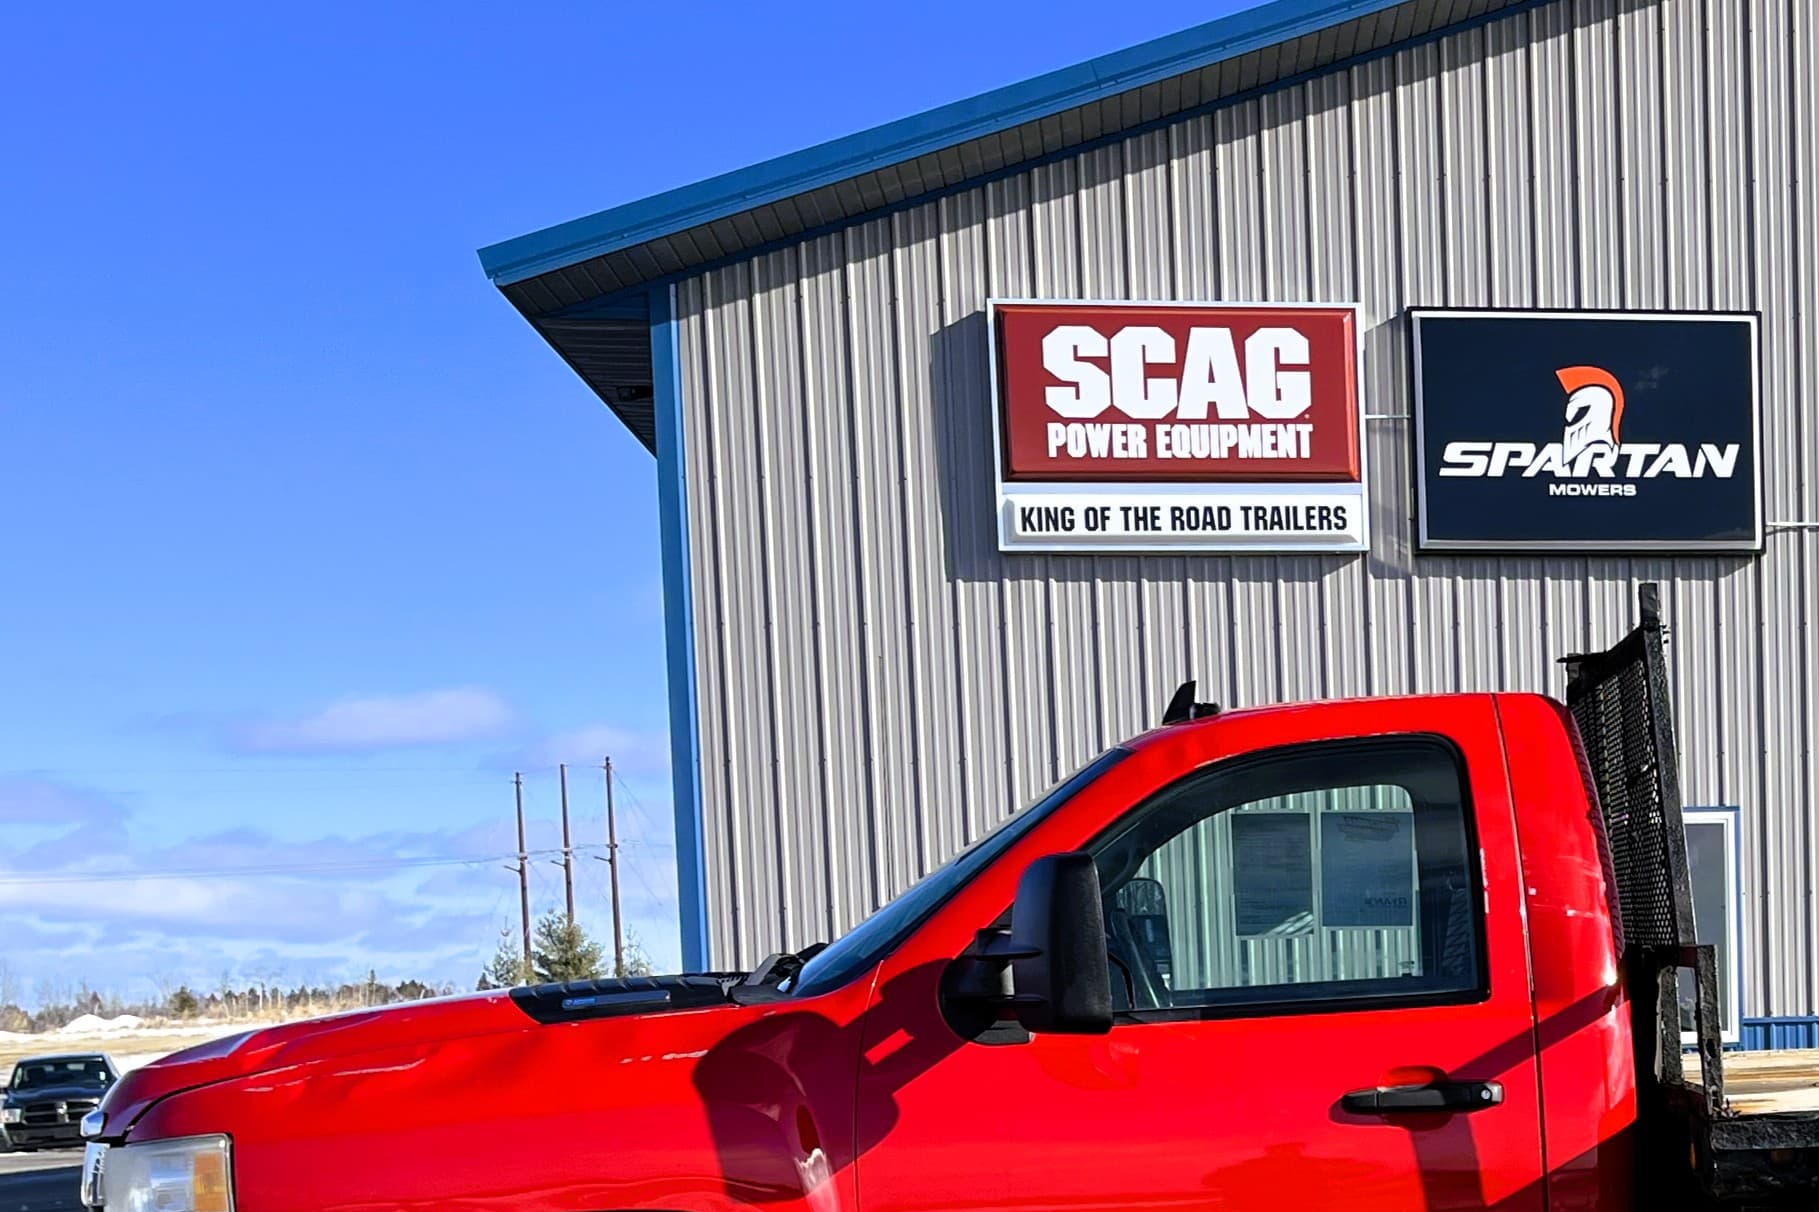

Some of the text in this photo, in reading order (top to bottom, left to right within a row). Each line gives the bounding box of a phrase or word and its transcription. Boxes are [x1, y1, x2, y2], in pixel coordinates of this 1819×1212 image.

[1042, 325, 1312, 419] SCAG
[1047, 423, 1314, 459] POWER EQUIPMENT
[1439, 441, 1740, 478] SPARTAN
[1549, 484, 1637, 496] MOWERS
[1020, 505, 1347, 532] KING OF THE ROAD TRAILERS
